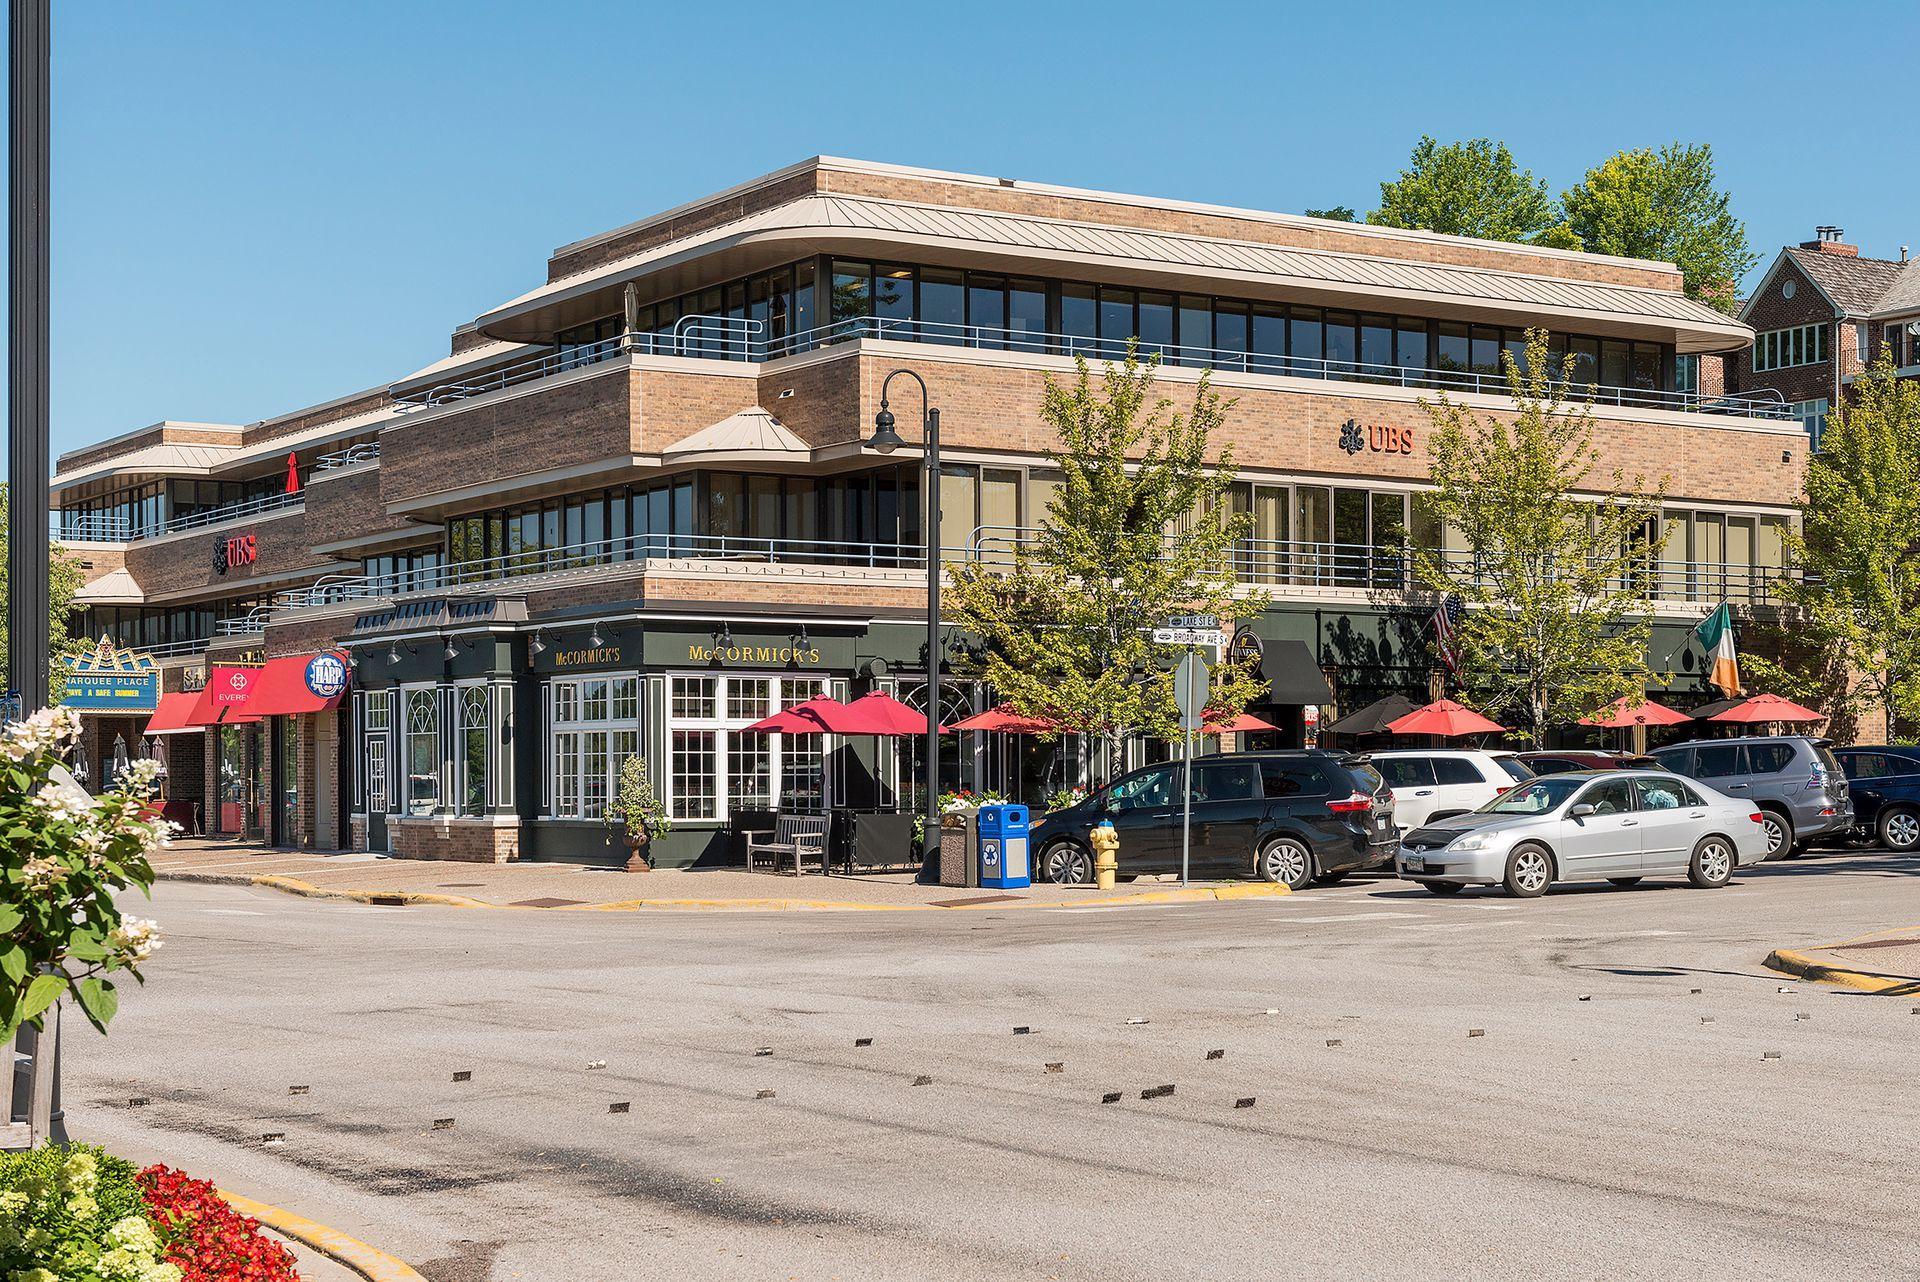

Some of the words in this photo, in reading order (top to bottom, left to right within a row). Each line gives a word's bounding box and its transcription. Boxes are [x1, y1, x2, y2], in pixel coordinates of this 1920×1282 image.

[1368, 424, 1415, 455] UBS
[227, 534, 257, 568] UBS
[1182, 616, 1197, 627] LAKE
[1198, 616, 1207, 626] ST
[1173, 632, 1206, 644] BROADWAY
[1207, 634, 1218, 645] AVE
[555, 647, 620, 666] McCORMICK'S
[690, 645, 820, 664] McCORMICK'S
[117, 678, 149, 686] PLACE
[315, 665, 342, 685] HARP
[95, 689, 111, 697] SAFE
[114, 689, 140, 697] SUMMER
[218, 693, 249, 701] EVERE
